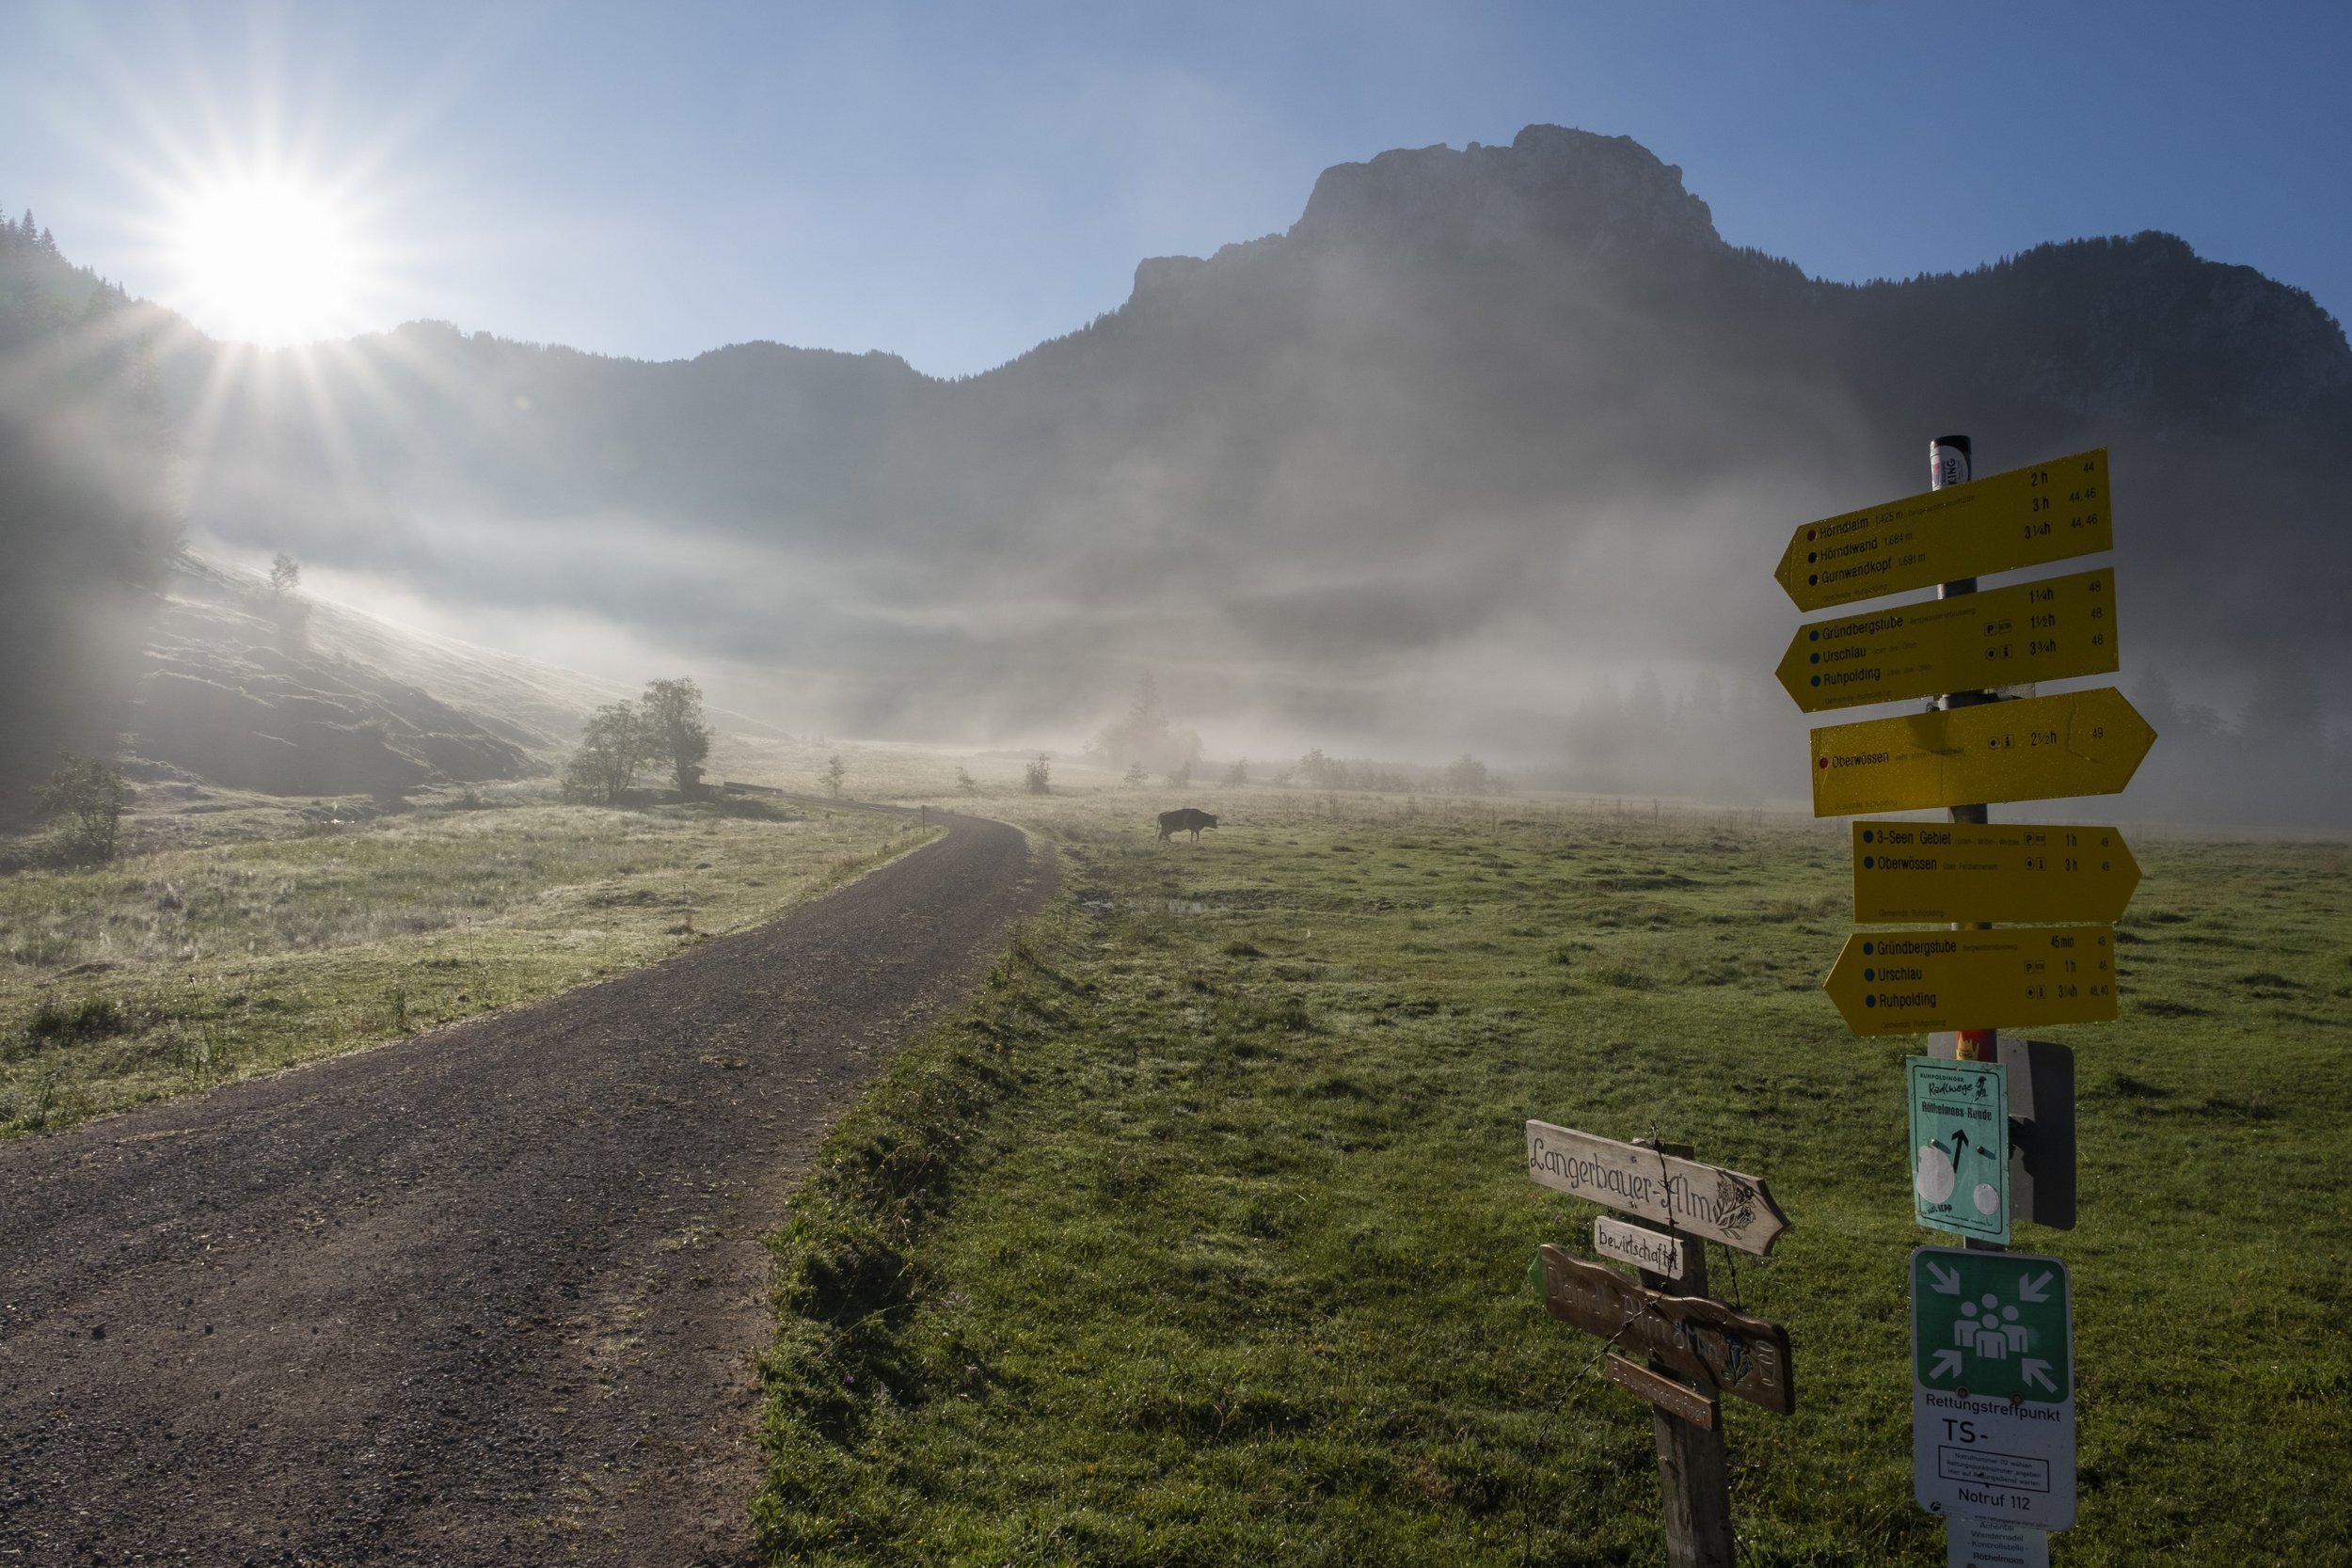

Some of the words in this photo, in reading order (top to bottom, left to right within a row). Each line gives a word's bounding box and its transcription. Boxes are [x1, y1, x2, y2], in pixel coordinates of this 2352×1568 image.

[2083, 461, 2094, 473] 44
[2031, 471, 2038, 486] 2
[2033, 497, 2040, 513] 3
[1820, 517, 1869, 539] Hörndlalm
[1820, 537, 1878, 562] Hörndlwand
[1821, 557, 1892, 584] Gurnwandkopf
[2089, 579, 2102, 594] 48
[2090, 606, 2104, 620] 48
[1822, 616, 1903, 641] Gründbergstube
[2091, 633, 2105, 646] 48
[1823, 646, 1867, 663] Urschlau
[1824, 667, 1882, 687] Ruhpolding
[2091, 727, 2104, 739] 49
[1832, 752, 1889, 769] Oberwössen
[1919, 831, 1951, 846] Gebiet
[1878, 856, 1938, 871] Oberwössen
[2065, 858, 2071, 872] 3
[1877, 941, 1957, 957] Gründbergstube
[1878, 967, 1923, 981] Urschlau
[1880, 993, 1936, 1008] Ruhpolding
[1920, 1073, 1964, 1083] RUHPOLDINGER
[1929, 1083, 1973, 1096] Radlwege
[1530, 1137, 1712, 1223] Langerbauer-Alm
[1926, 1394, 2060, 1422] Rettungstreffpunkt
[1955, 1452, 1998, 1465] Notrufnummer
[2010, 1461, 2033, 1469] wählen
[2015, 1470, 2042, 1479] angeben
[2019, 1478, 2041, 1486] warten
[1958, 1487, 2006, 1508] Notruf
[2010, 1495, 2031, 1511] 112
[1970, 1529, 2025, 1543] Wandernadel
[1971, 1540, 2025, 1552] Kontrollstelle
